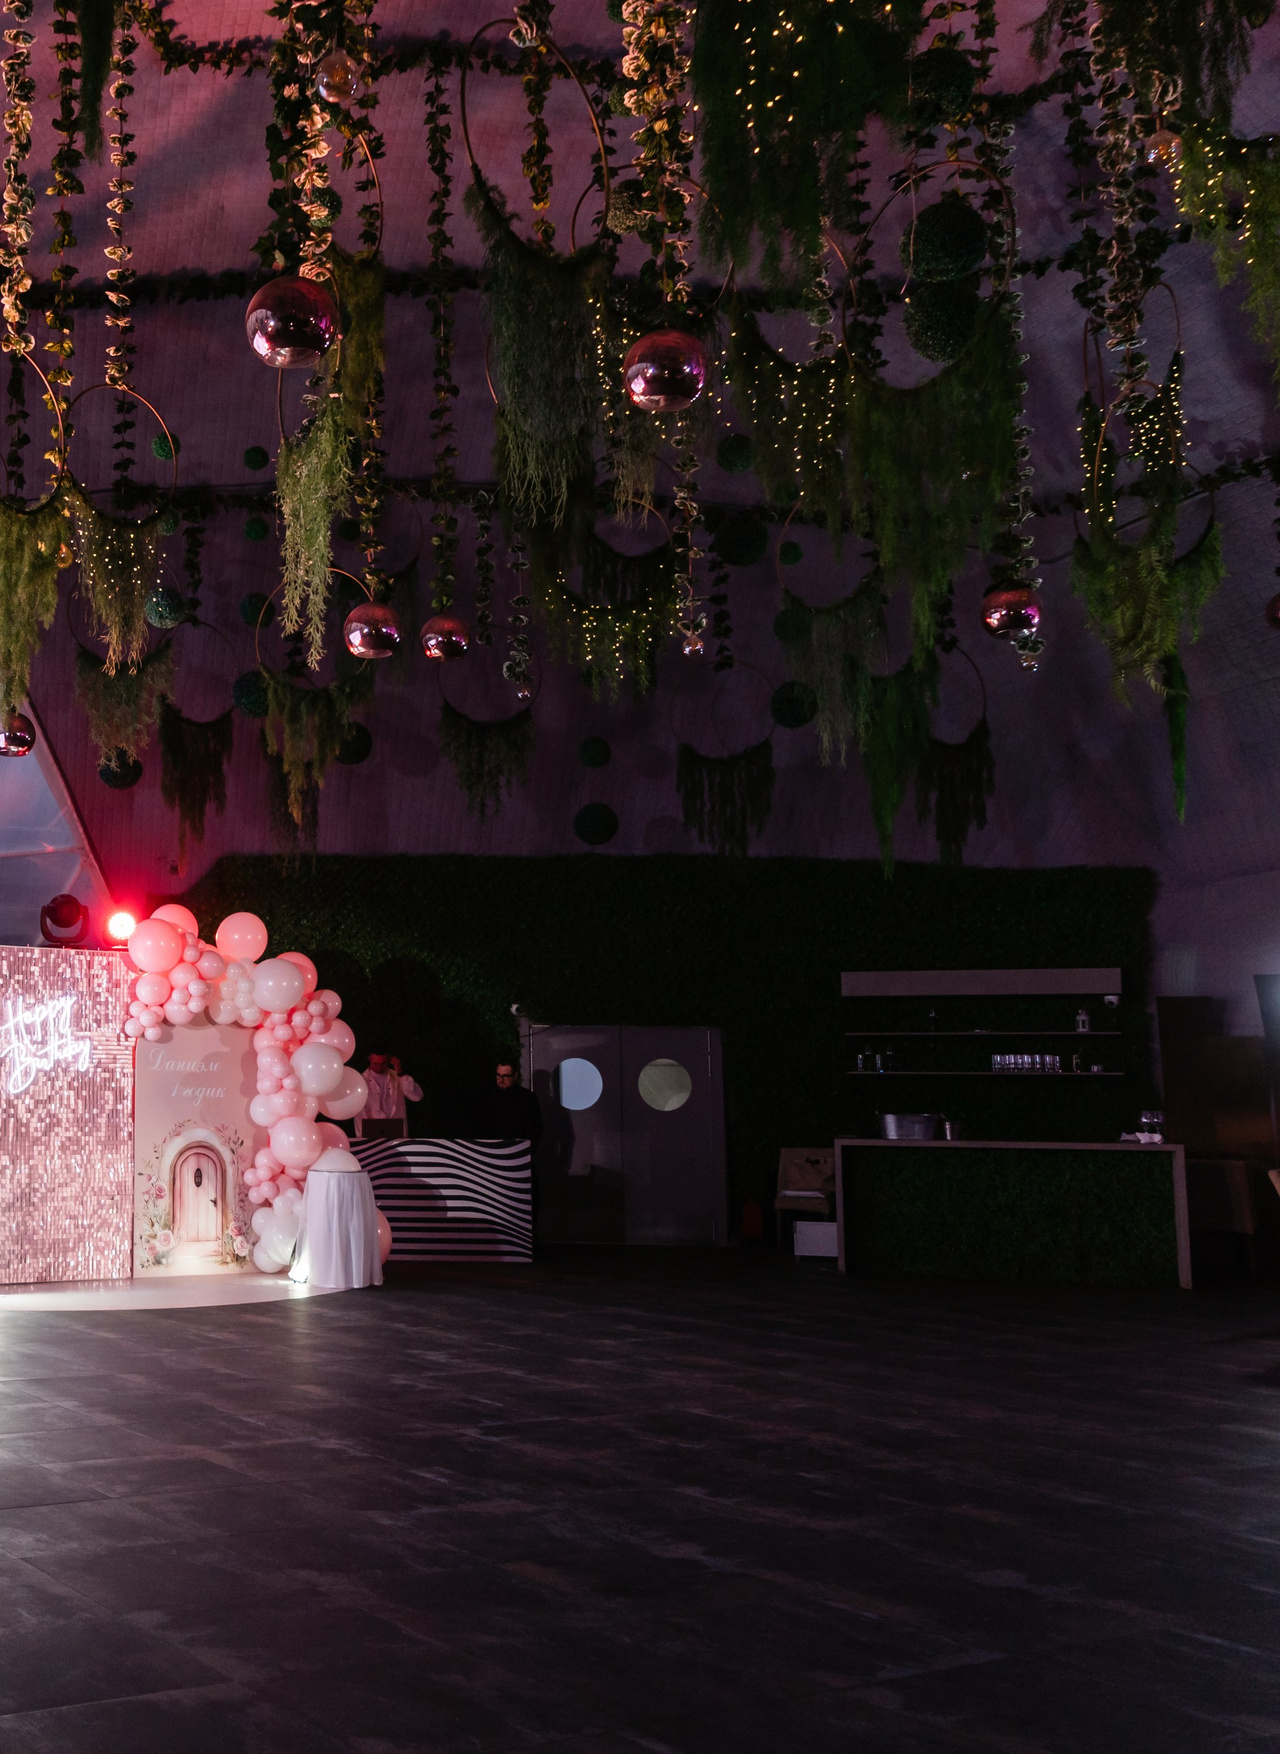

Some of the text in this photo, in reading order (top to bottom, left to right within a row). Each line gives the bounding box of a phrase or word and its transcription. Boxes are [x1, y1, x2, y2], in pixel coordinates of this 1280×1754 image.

[0, 995, 77, 1050] Happy
[0, 1034, 90, 1094] Birthday
[171, 1083, 226, 1107] 1 годик
